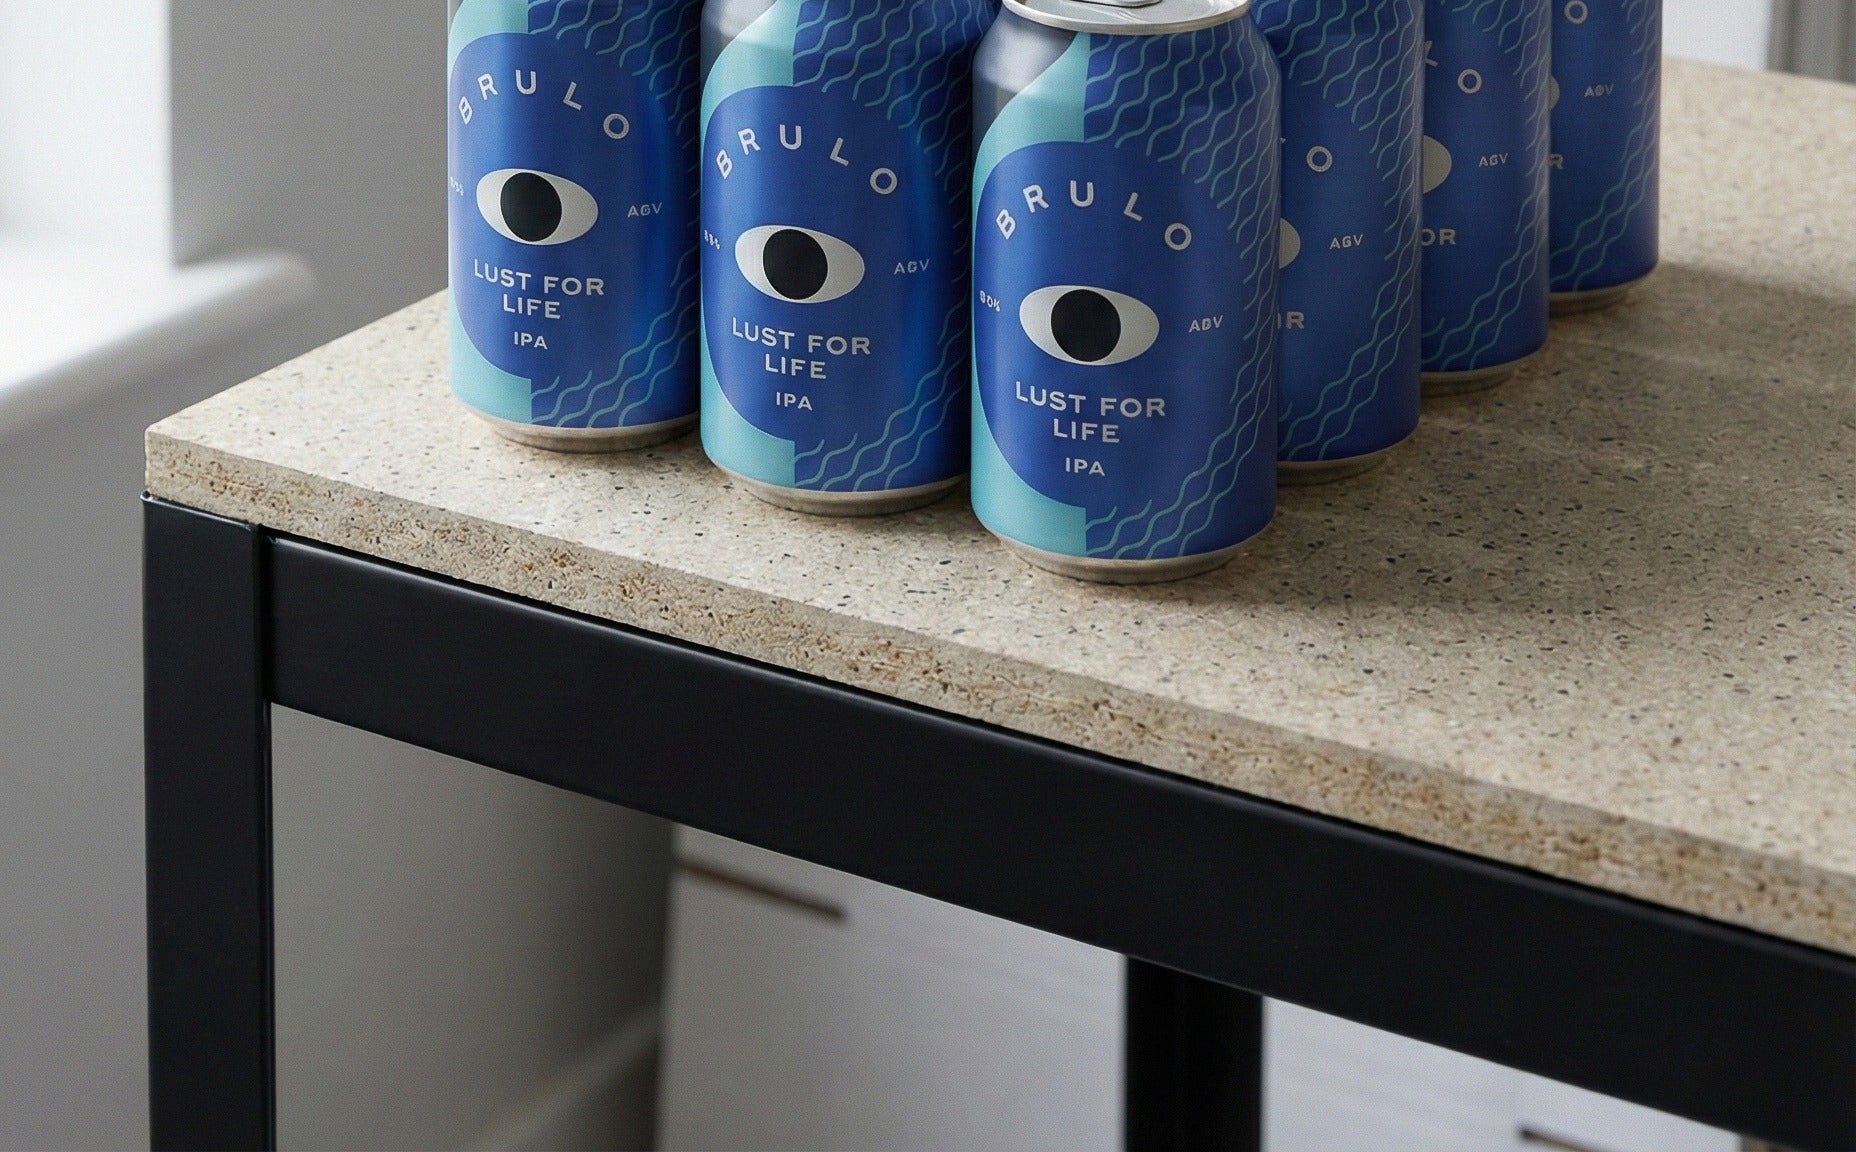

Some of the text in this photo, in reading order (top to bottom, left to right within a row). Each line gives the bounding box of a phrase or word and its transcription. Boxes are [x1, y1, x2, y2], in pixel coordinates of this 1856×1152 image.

[458, 69, 630, 140] BRULO
[716, 124, 898, 195] BRULO
[996, 180, 1192, 250] BRULO
[1422, 228, 1456, 246] OR
[474, 259, 605, 296] LUST FOR
[503, 294, 561, 319] LIFE
[514, 331, 548, 350] IPA
[732, 317, 870, 356] LUST FOR
[765, 353, 827, 379] LIFE
[776, 392, 813, 411] IPA
[1015, 381, 1166, 418] LUST FOR
[1053, 418, 1120, 443] LIFE
[1065, 457, 1106, 477] IPA
